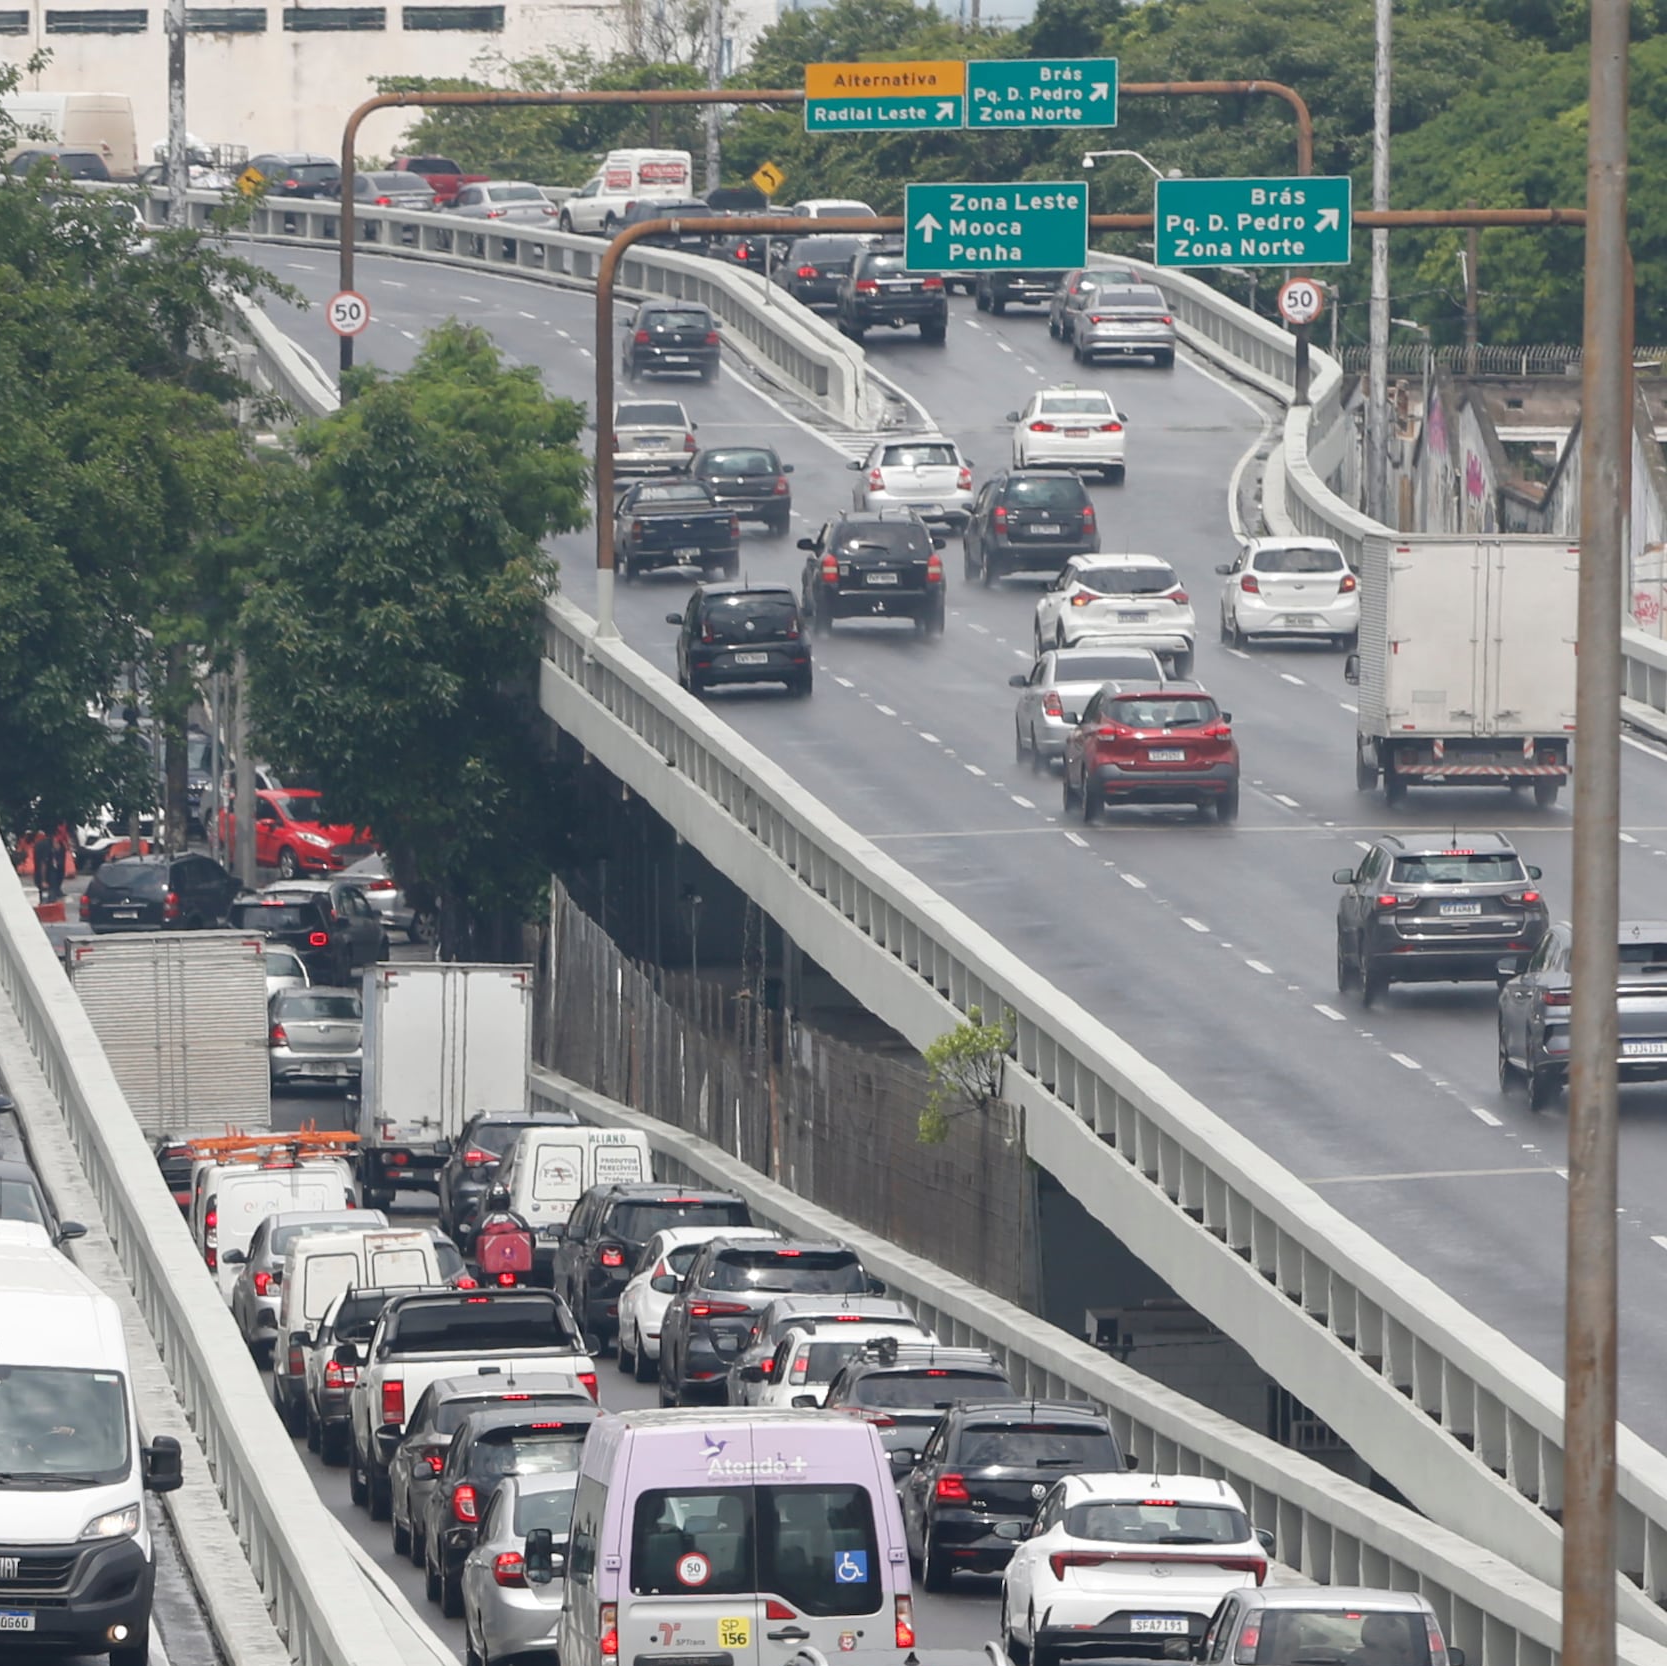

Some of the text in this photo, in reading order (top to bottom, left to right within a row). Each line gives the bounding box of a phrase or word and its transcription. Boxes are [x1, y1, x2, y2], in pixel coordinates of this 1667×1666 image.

[833, 74, 937, 88] Alternativa
[1040, 66, 1082, 81] Brás
[974, 86, 1083, 104] Pq. D. Pedro
[814, 105, 928, 121] Radial Leste
[980, 106, 1082, 121] Zona Norte
[950, 192, 1079, 211] Zona Leste
[1251, 186, 1306, 205] Brás
[949, 218, 1022, 236] Mooca
[1166, 212, 1306, 236] Pq. D. Pedro
[949, 243, 1022, 261] Penha
[1174, 238, 1305, 257] Zona Norte
[1287, 290, 1313, 308] 50
[335, 303, 361, 321] 50
[686, 1563, 702, 1574] 50
[721, 1619, 740, 1632] SP
[722, 1632, 747, 1645] 156
